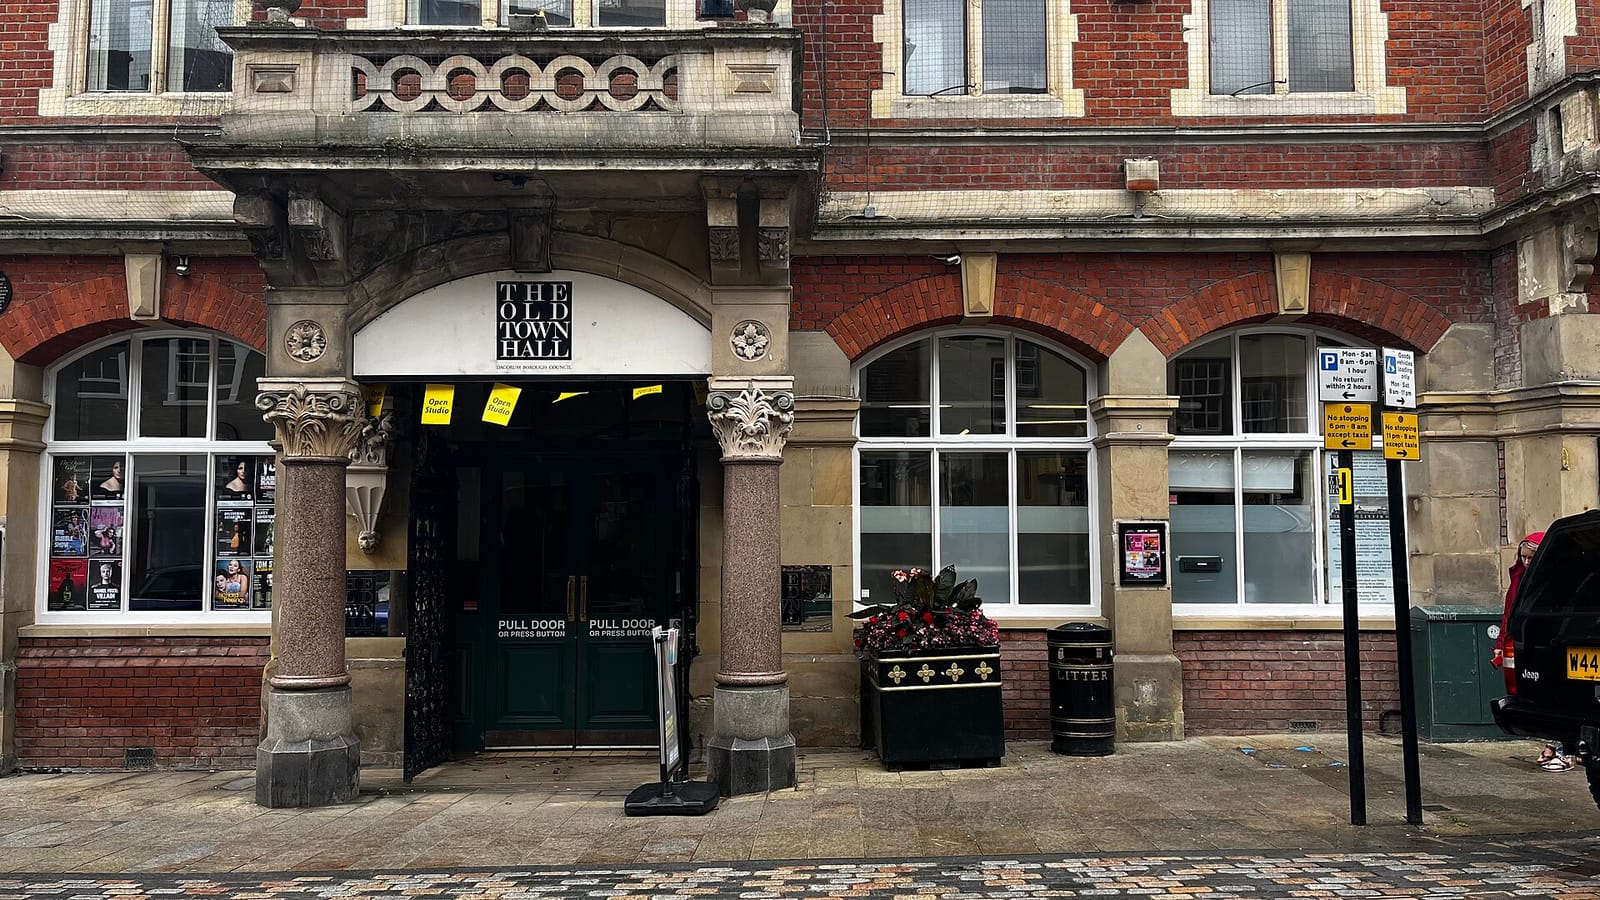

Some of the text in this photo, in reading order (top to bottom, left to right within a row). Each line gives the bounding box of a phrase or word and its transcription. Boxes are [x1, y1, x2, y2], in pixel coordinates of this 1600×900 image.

[500, 283, 568, 302] THE
[500, 302, 568, 320] OLD
[500, 320, 570, 339] TOWN
[500, 340, 569, 358] HALL
[493, 397, 512, 408] Open
[488, 404, 510, 416] Studio
[498, 620, 565, 630] PULL DOOR
[590, 619, 655, 629] PULL DOOR
[1570, 653, 1599, 672] W44
[1058, 670, 1108, 681] LITTER
[1522, 669, 1539, 682] Jeep
